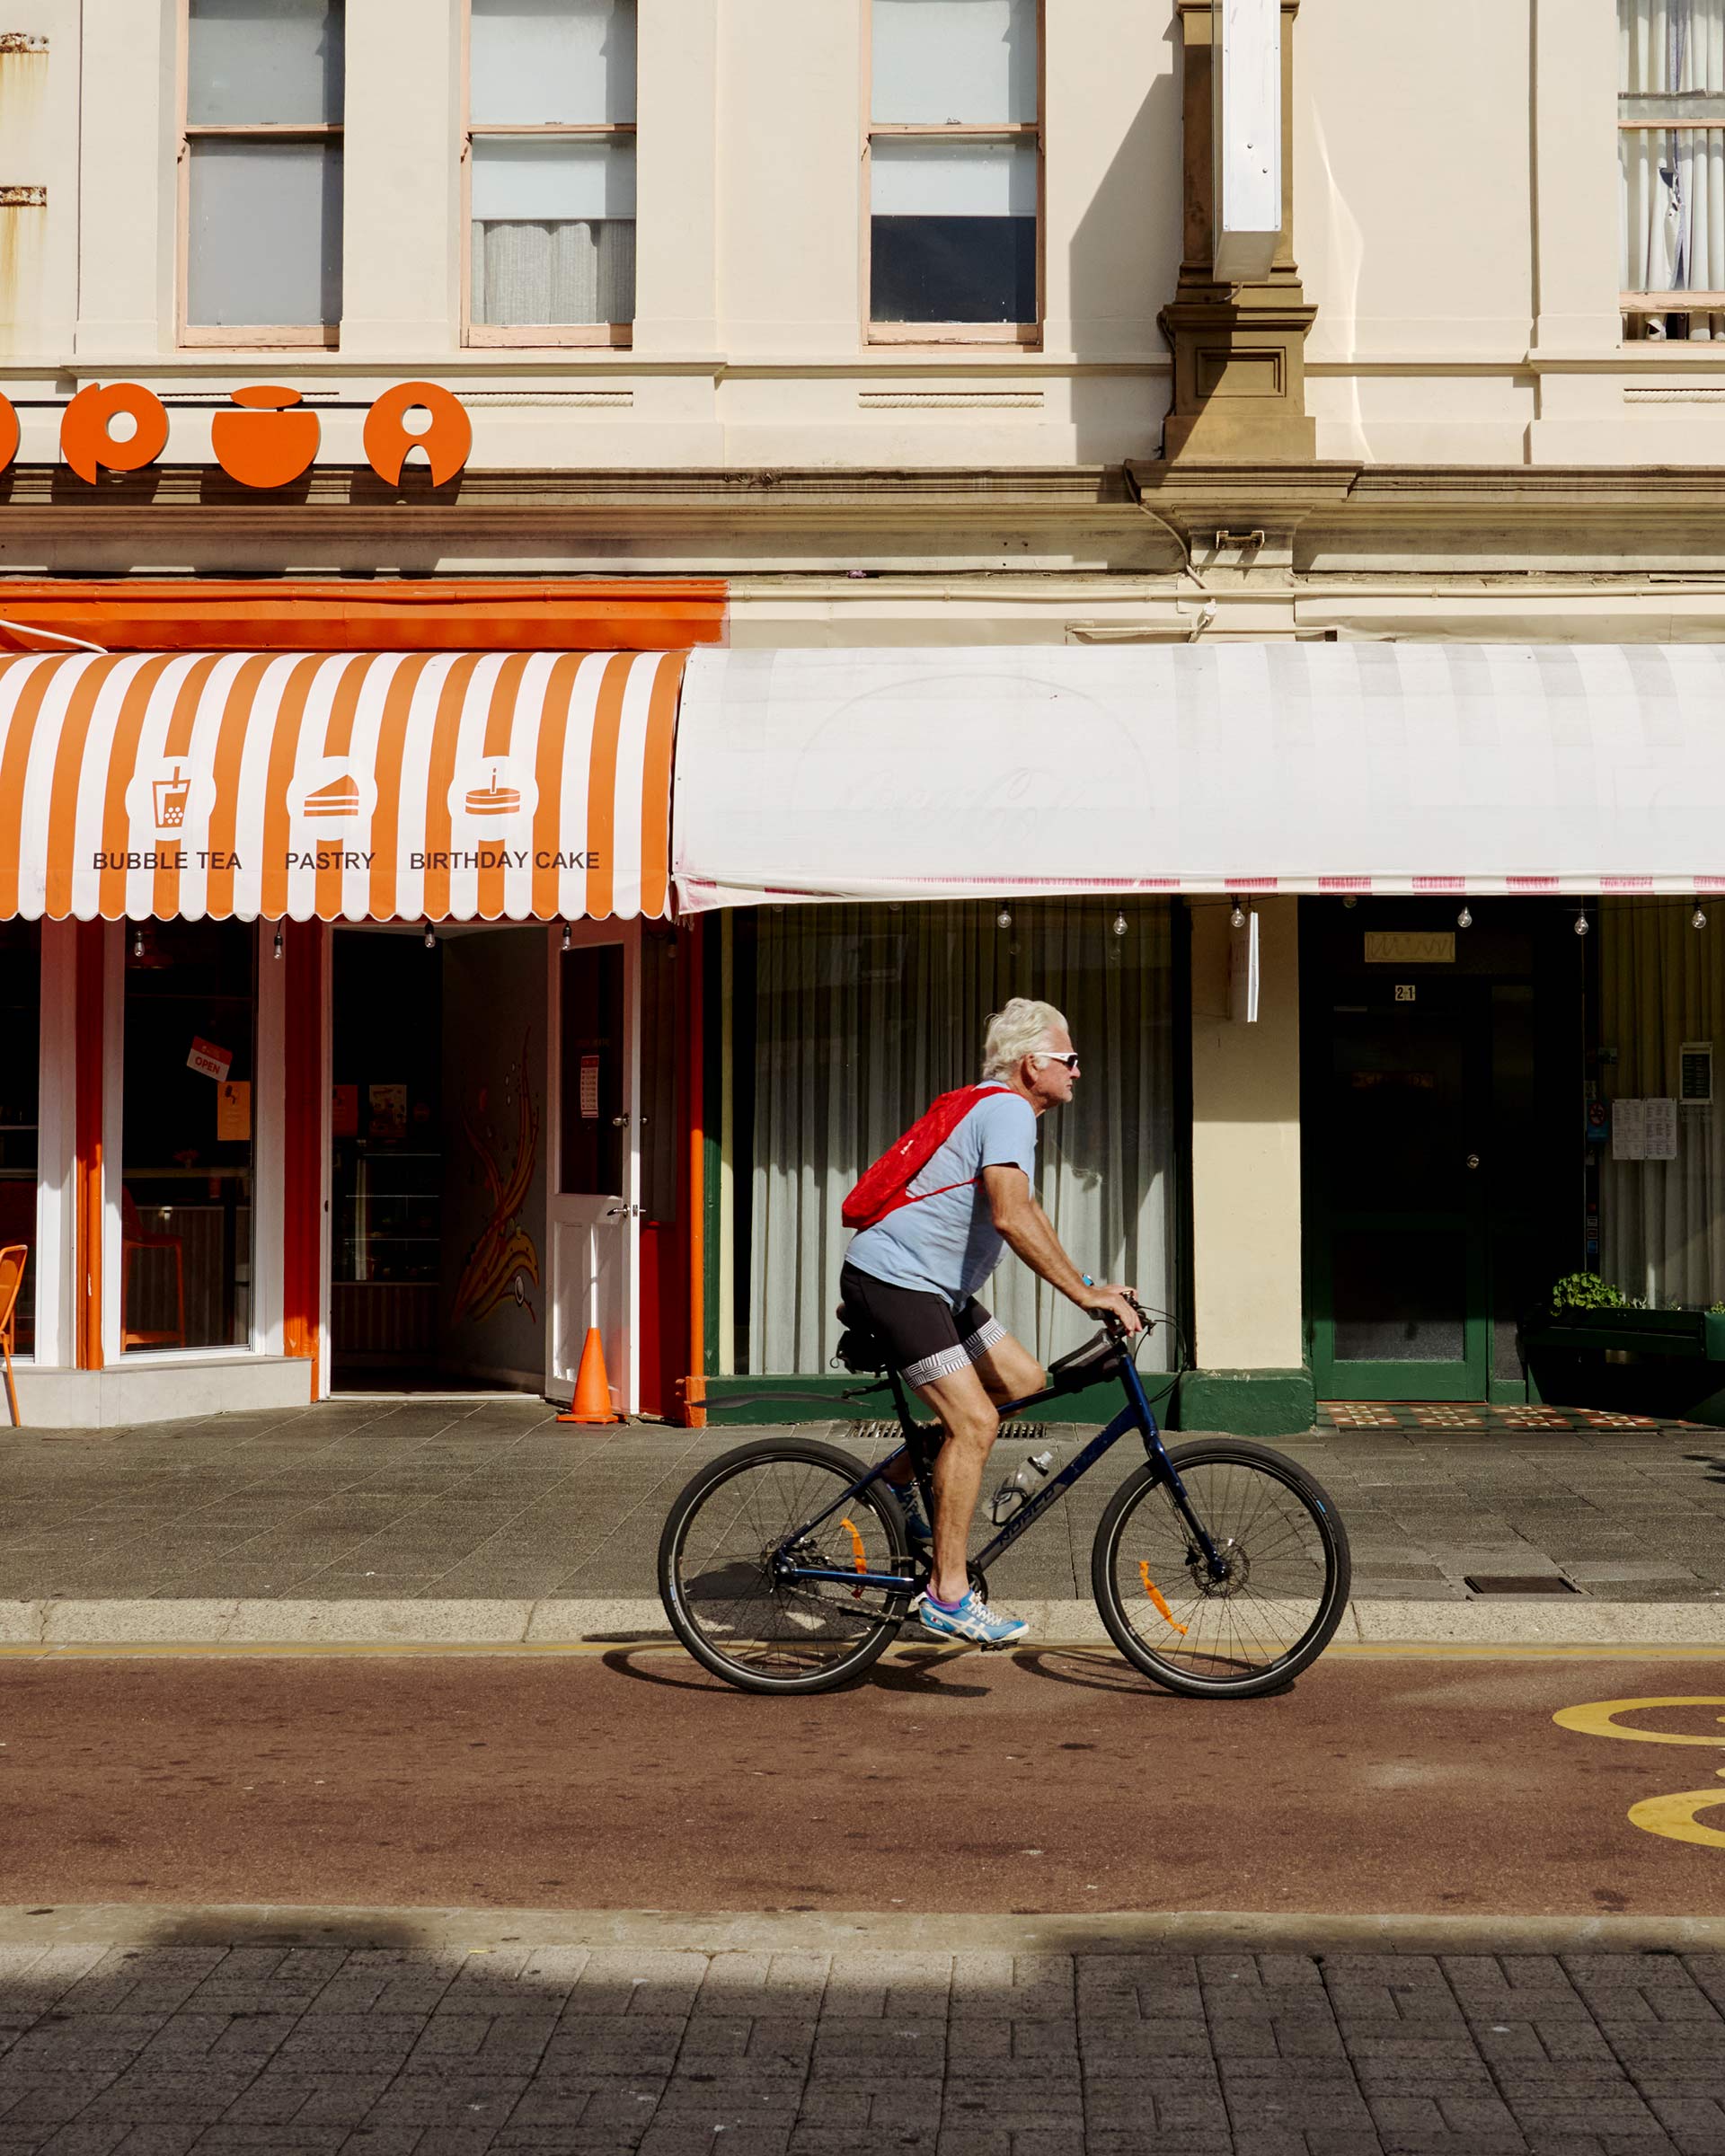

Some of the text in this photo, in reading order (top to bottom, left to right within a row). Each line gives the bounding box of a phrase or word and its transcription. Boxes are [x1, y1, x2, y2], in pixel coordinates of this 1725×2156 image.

[93, 852, 243, 870] BUBBLE TEA
[285, 852, 376, 870] PASTRY
[411, 851, 599, 870] BIRTHDAY CAKE
[1396, 986, 1413, 1000] 21
[195, 1056, 220, 1074] OPEN
